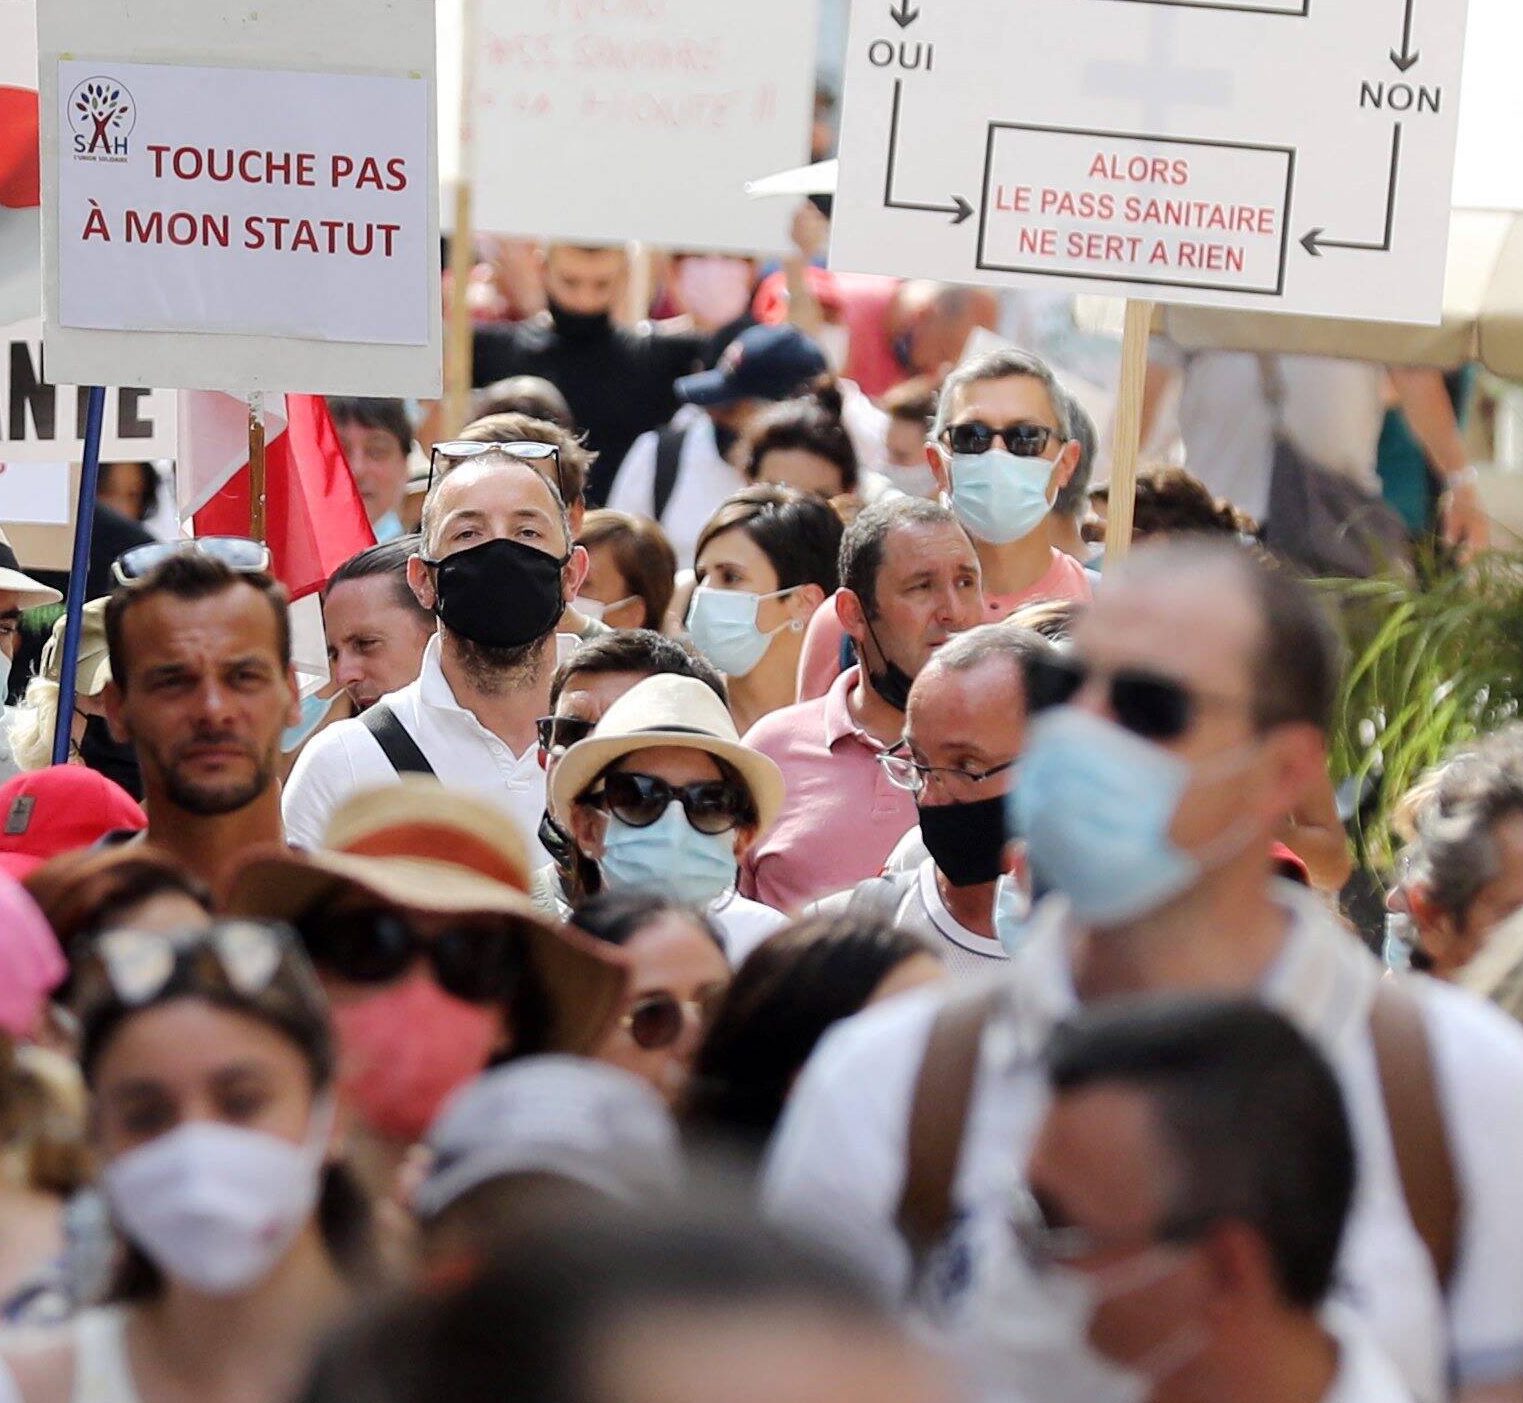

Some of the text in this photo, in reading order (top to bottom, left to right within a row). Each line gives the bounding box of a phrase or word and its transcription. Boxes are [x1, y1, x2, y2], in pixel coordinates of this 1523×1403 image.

[868, 39, 934, 72] OUI
[1359, 80, 1442, 115] NON
[147, 145, 408, 192] TOUCHE PAS
[1088, 152, 1189, 187] ALORS
[82, 197, 401, 257] À MON STATUT
[996, 185, 1275, 235] LE PASS SANITAIRE
[1019, 227, 1245, 272] NE SERT A RIEN
